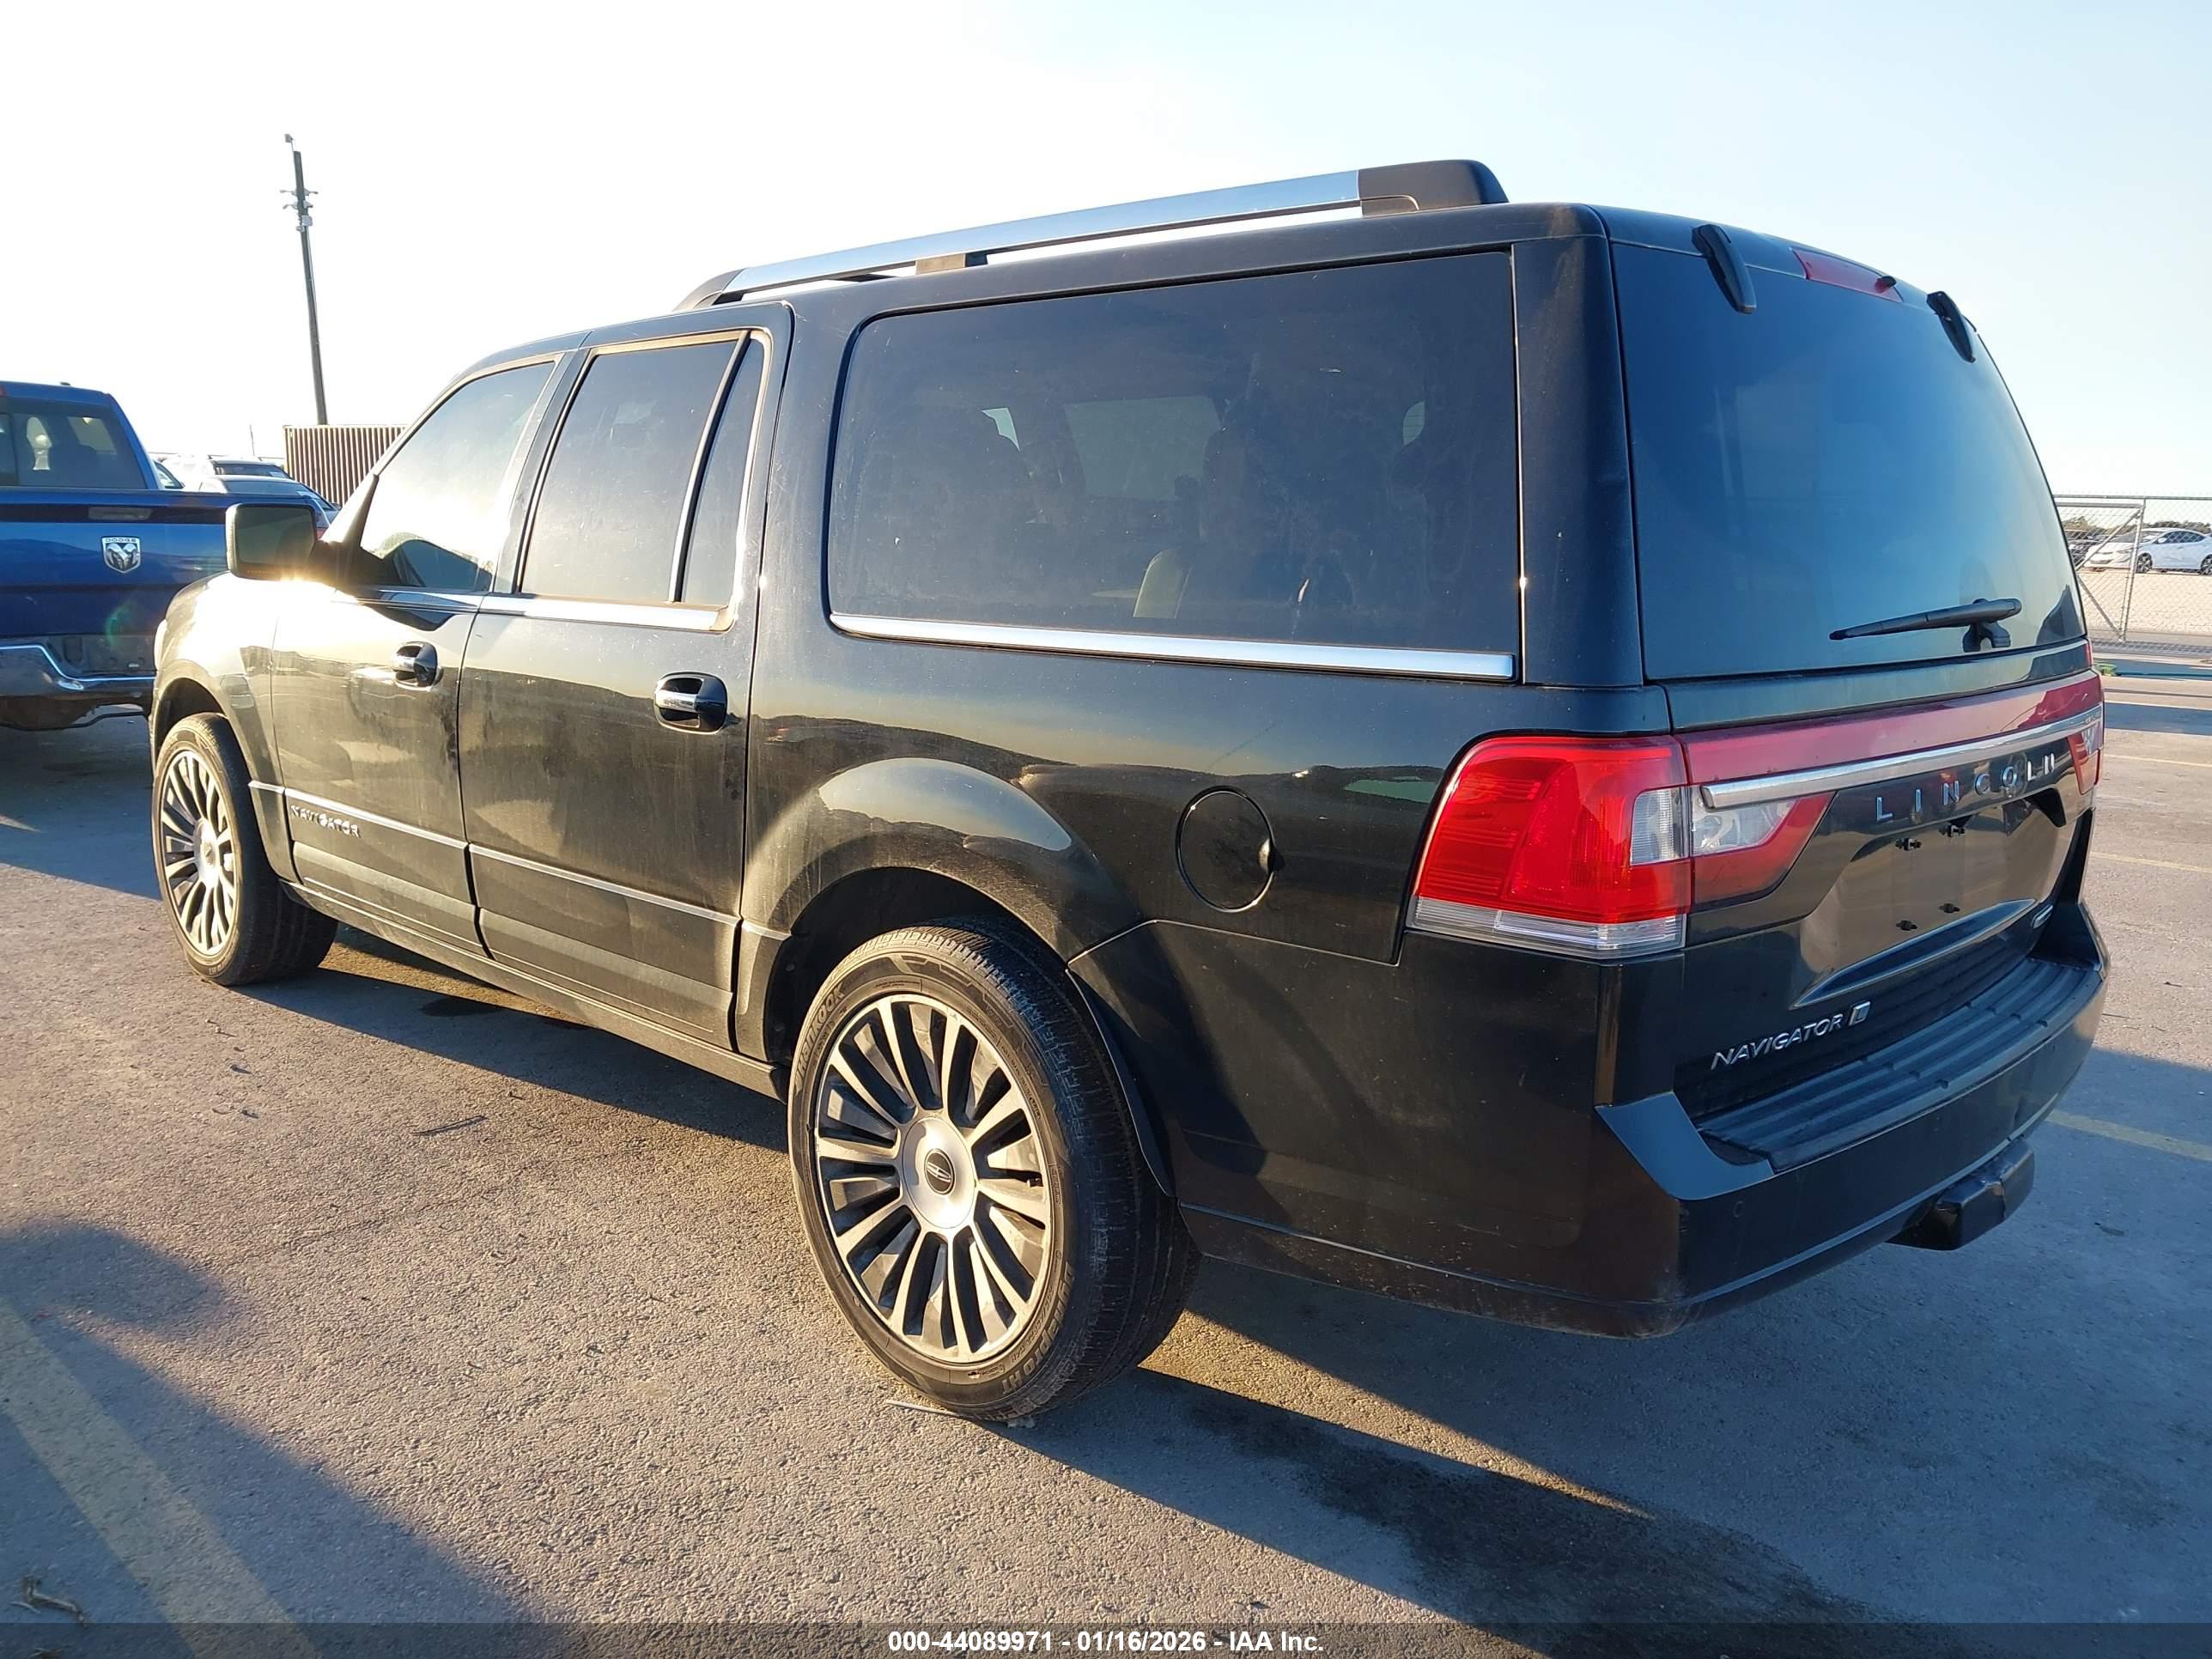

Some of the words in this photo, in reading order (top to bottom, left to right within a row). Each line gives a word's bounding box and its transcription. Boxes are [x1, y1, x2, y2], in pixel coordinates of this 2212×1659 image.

[1876, 752, 2056, 822] LINCOLN
[290, 805, 361, 836] NAVIGATOR
[1711, 1013, 1844, 1070] NAVIGATOR
